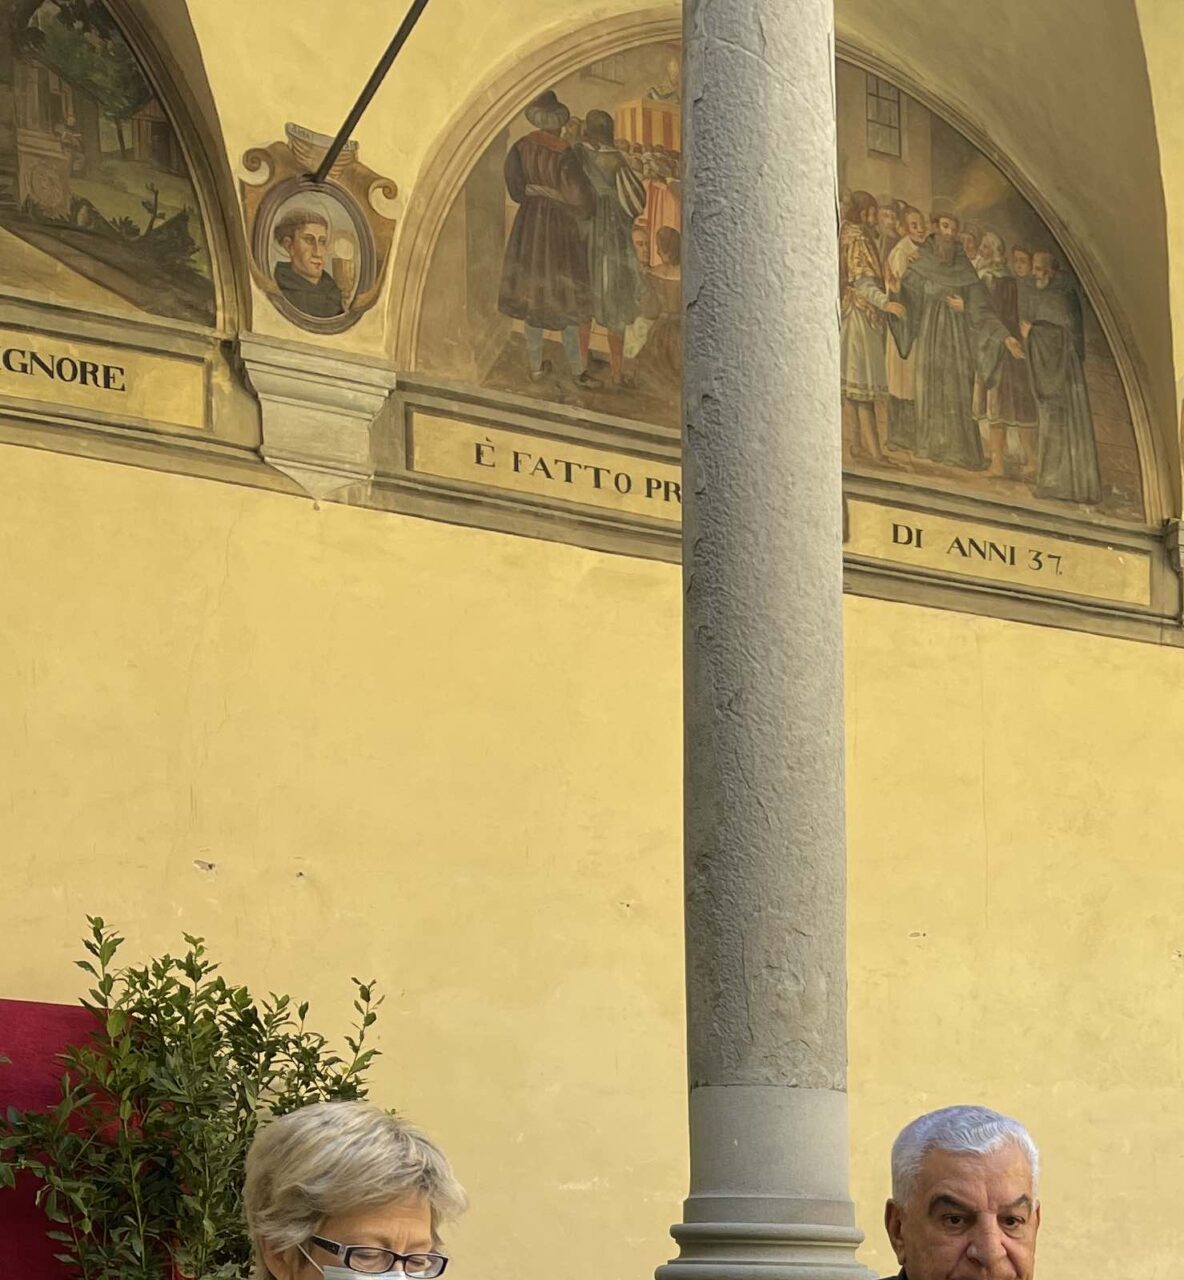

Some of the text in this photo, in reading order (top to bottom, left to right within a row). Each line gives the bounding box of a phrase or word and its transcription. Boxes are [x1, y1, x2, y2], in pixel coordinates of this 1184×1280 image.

[0, 346, 125, 391] GNORE
[474, 436, 495, 467] È
[512, 450, 632, 494] FATTO
[892, 523, 1063, 576] DI ANNI 37.
